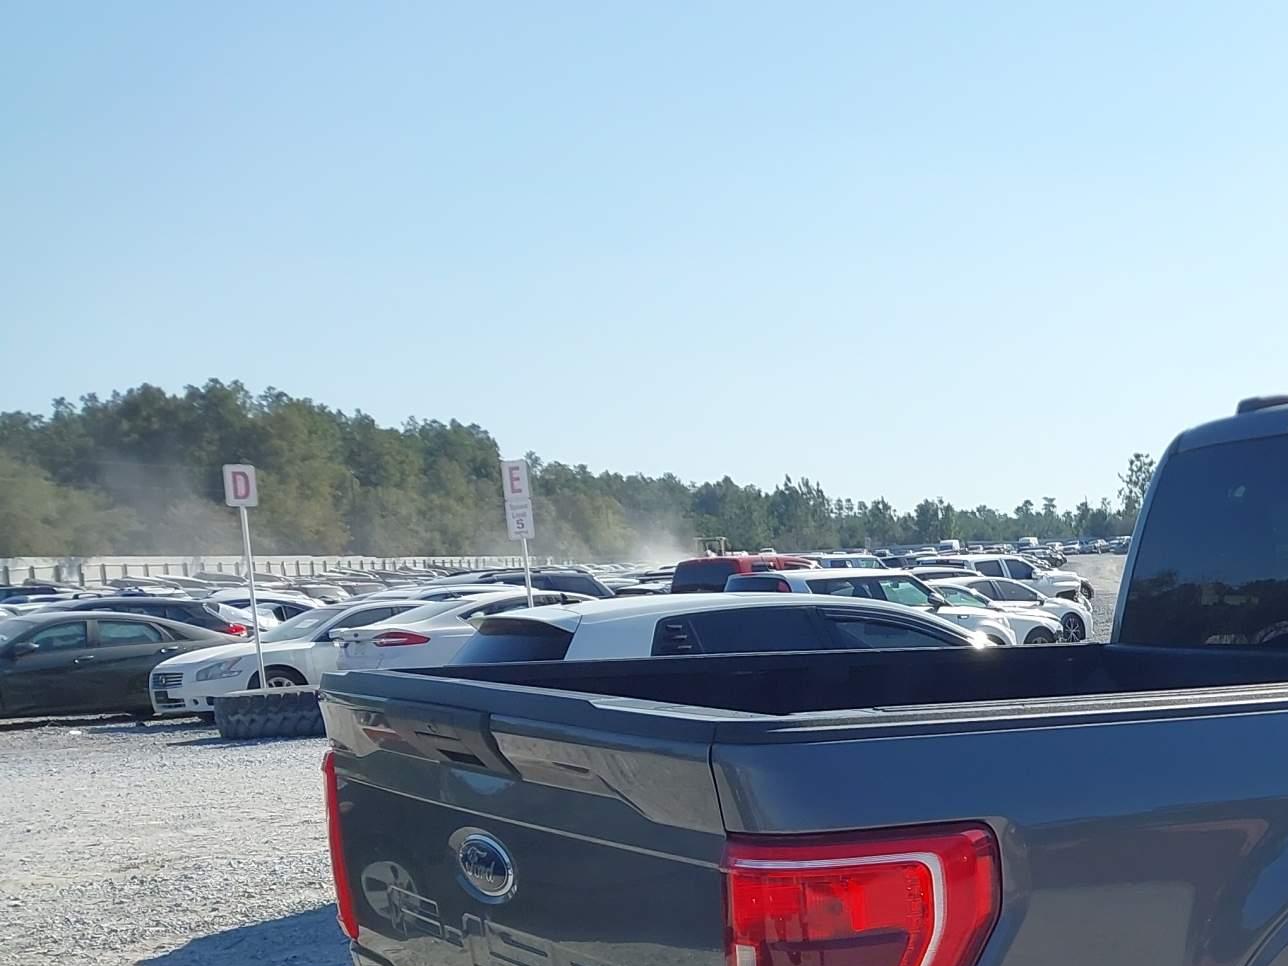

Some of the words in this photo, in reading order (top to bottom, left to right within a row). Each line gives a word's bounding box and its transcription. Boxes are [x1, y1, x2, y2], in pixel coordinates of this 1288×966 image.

[231, 471, 250, 499] D
[509, 466, 522, 493] E
[516, 519, 525, 529] 5
[465, 846, 496, 883] Ford
